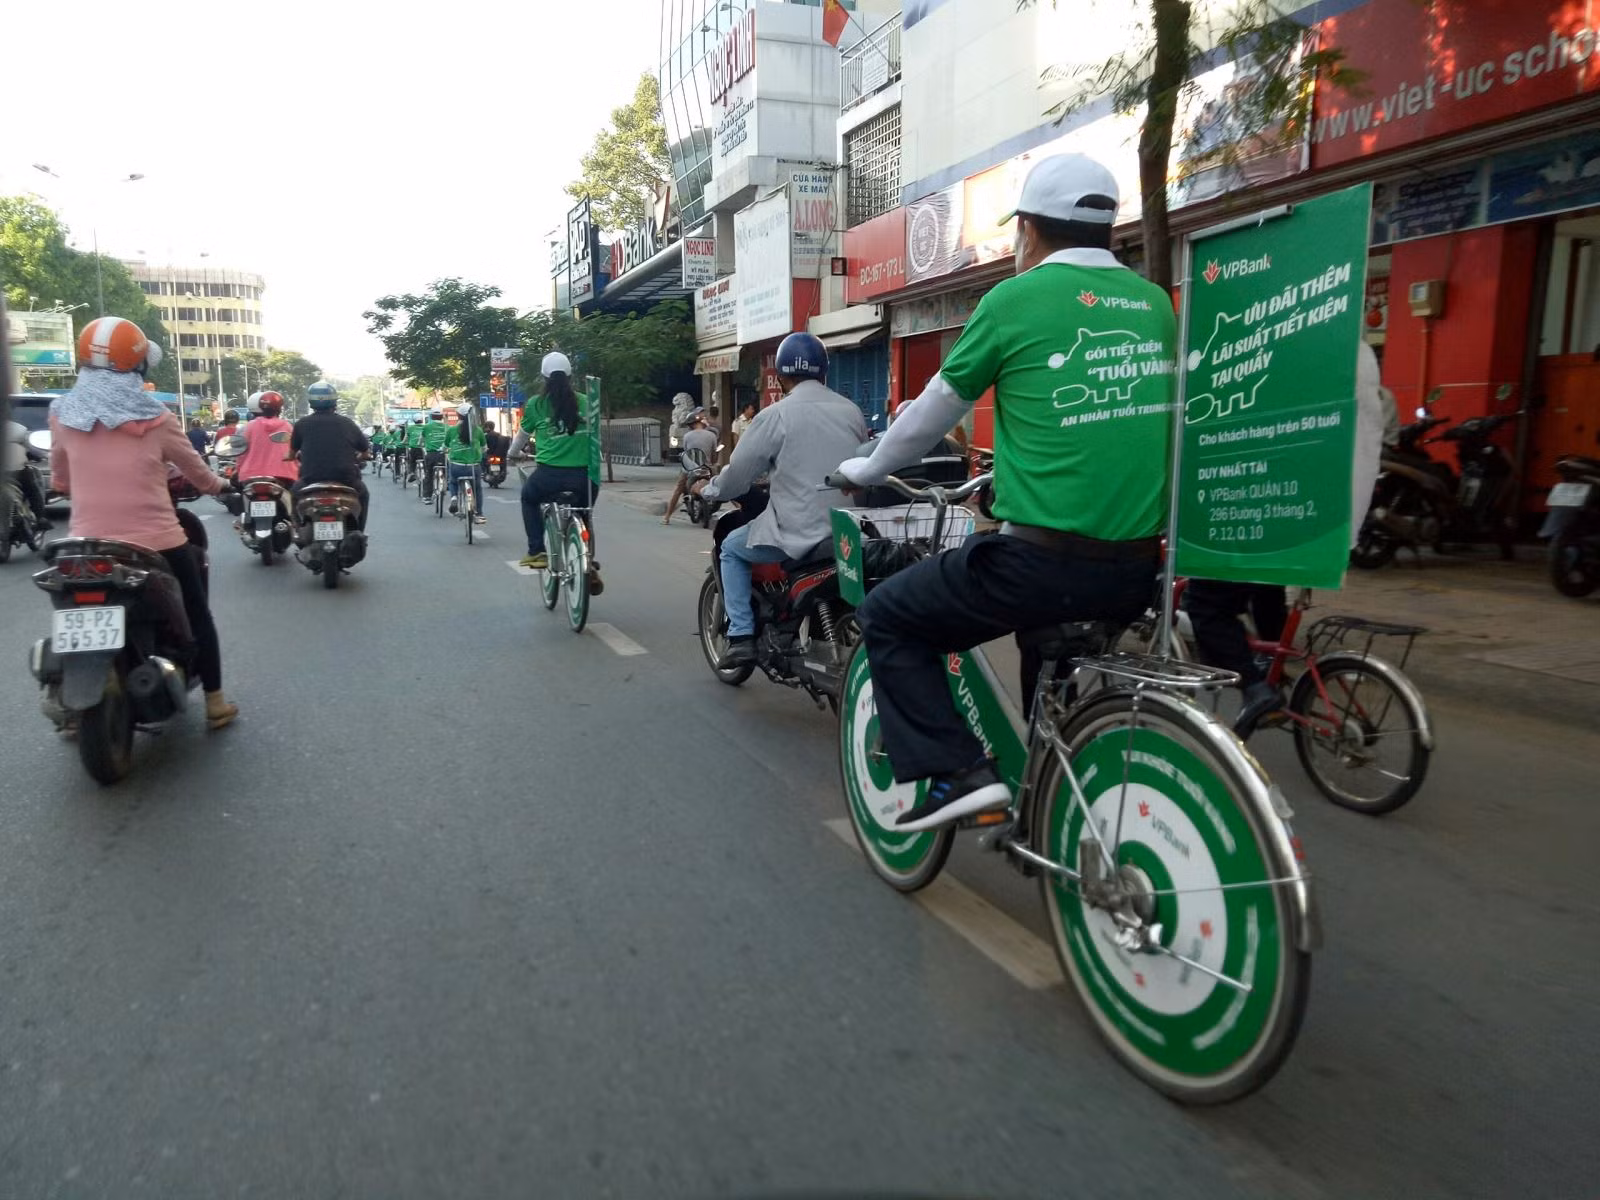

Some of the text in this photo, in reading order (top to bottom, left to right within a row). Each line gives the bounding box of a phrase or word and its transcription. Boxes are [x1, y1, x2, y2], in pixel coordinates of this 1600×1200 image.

[1503, 27, 1600, 85] scho
[798, 184, 809, 193] XE
[1221, 253, 1273, 280] VPBank
[1101, 296, 1152, 311] VPBank
[1243, 262, 1352, 326] ƯU ĐÃI THÊM
[1211, 294, 1349, 366] LÃI SUẤT TIẾT KIỆM
[1084, 346, 1107, 361] GÓI
[1110, 340, 1135, 358] TIẾT
[794, 357, 809, 370] ila
[1211, 368, 1234, 389] TẠI
[1060, 415, 1078, 428] AN
[1198, 434, 1217, 446] Cho
[1218, 428, 1248, 443] khách
[1249, 423, 1275, 439] hàng
[1276, 419, 1299, 435] trên
[1301, 416, 1316, 430] 50
[1198, 467, 1217, 480] DUY
[1219, 461, 1247, 478] NHẤT
[1210, 486, 1247, 502] VPBank
[1284, 480, 1299, 495] 10
[1209, 506, 1229, 521] 296
[1263, 504, 1272, 519] 3
[1272, 501, 1305, 519] tháng
[1249, 525, 1264, 539] 10
[957, 677, 994, 759] VPBank
